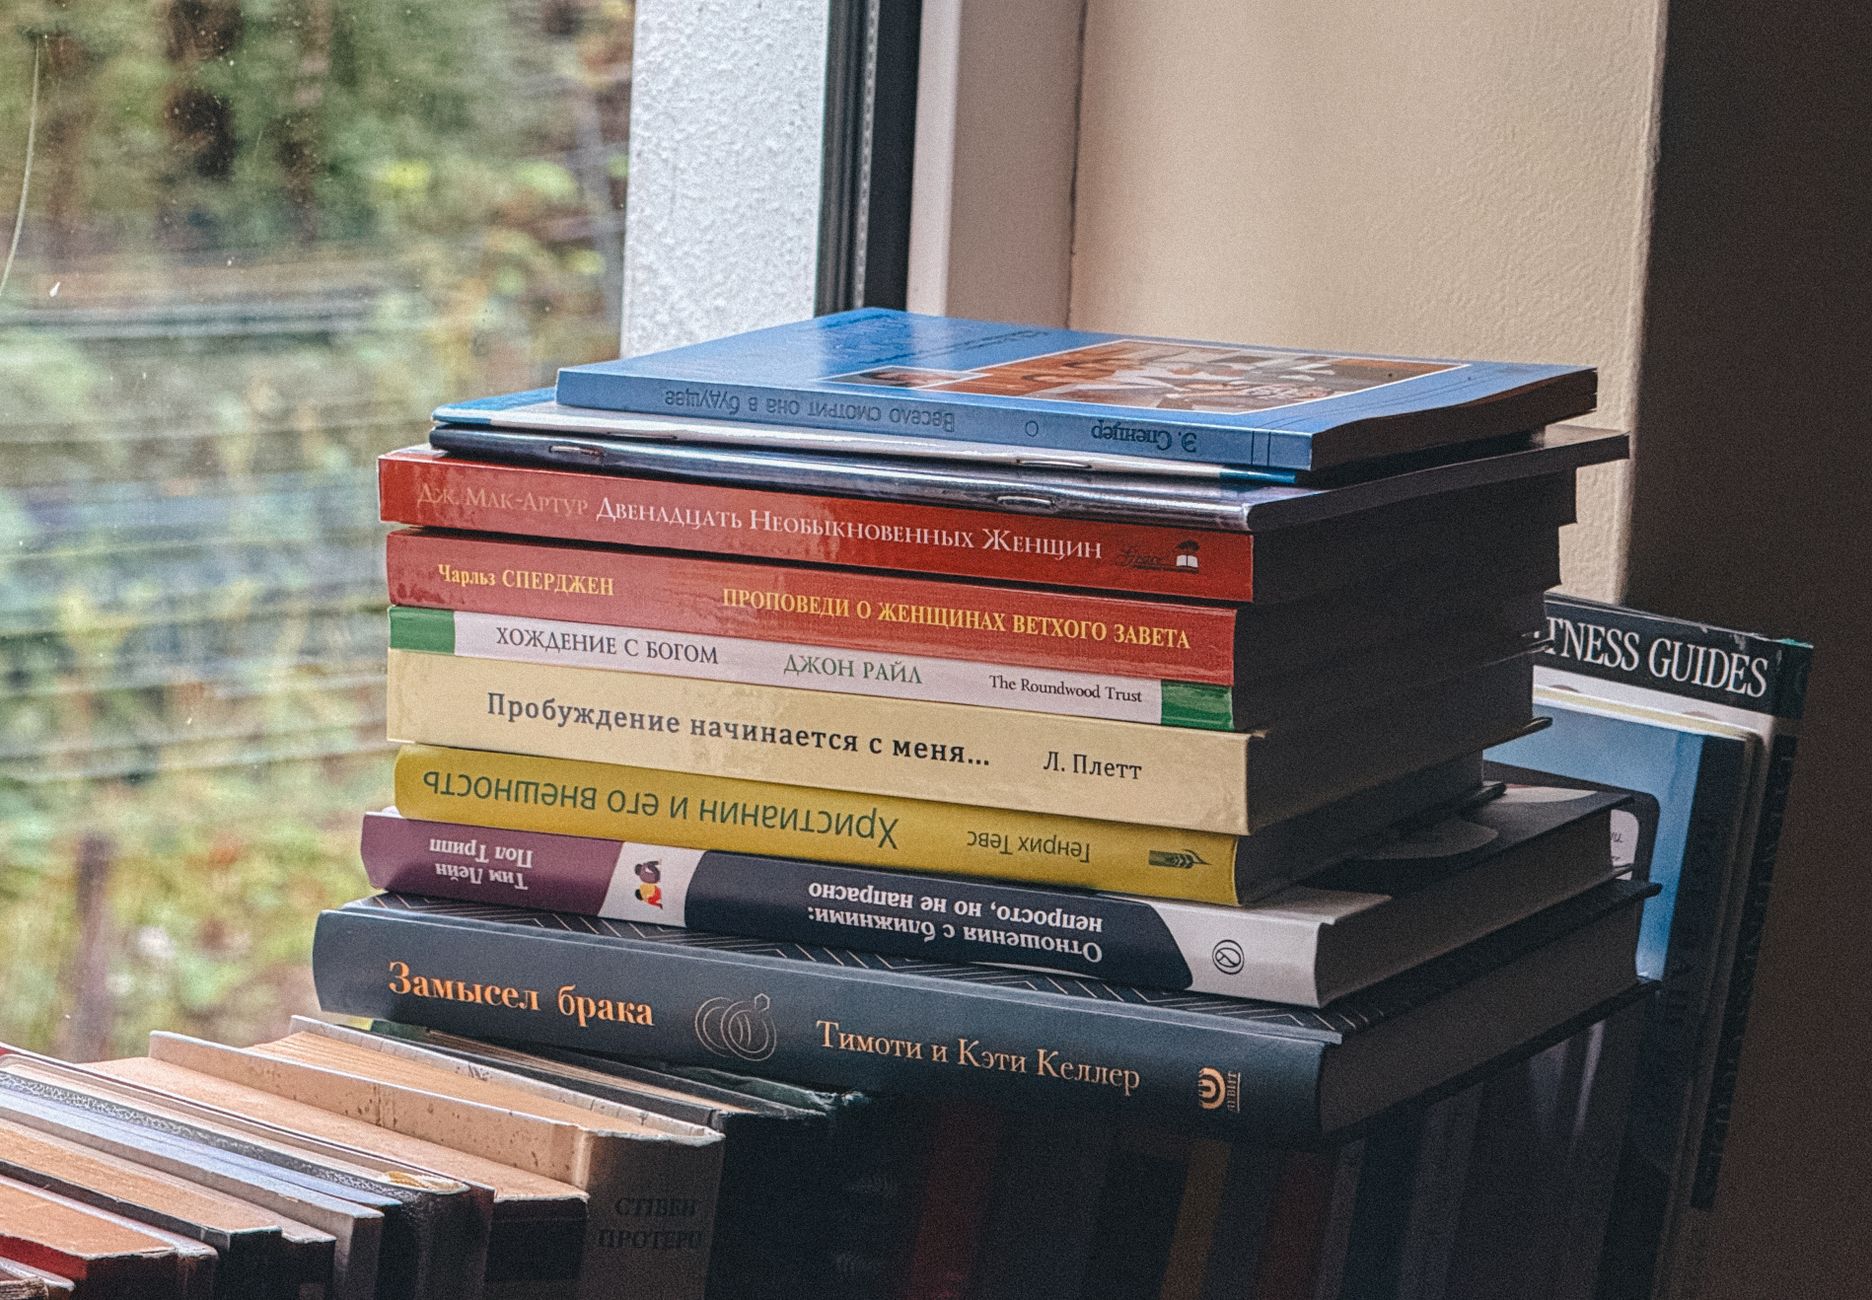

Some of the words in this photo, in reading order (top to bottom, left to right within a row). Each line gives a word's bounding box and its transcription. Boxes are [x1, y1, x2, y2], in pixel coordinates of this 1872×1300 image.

[665, 388, 740, 415] будущее
[749, 396, 758, 412] в
[767, 399, 800, 416] она
[807, 399, 880, 424] смотрит
[889, 407, 955, 433] Весело
[1091, 419, 1173, 451] Спенцер
[1176, 430, 1198, 453] Э.
[438, 564, 496, 586] Чарльз
[502, 569, 615, 596] СПЕРДЖЕН
[723, 588, 850, 618] ПРОПОВЕДИ
[856, 600, 872, 620] О
[878, 602, 1006, 633] ЖЕНЩИНАХ
[1013, 615, 1108, 642] ВЕТХОГО
[1114, 623, 1191, 650] ЗАВЕТА
[496, 626, 617, 656] ХОЖДЕНИЕ
[624, 638, 640, 657] С
[646, 640, 719, 666] БОГОМ
[1534, 615, 1640, 673] TNESS
[1649, 637, 1769, 699] GUIDES
[783, 653, 853, 677] ДЖОН
[863, 660, 922, 685] РАЙЛ
[989, 674, 1017, 690] The
[1020, 678, 1101, 699] Roundwood
[1105, 686, 1143, 703] Trust
[487, 691, 680, 734] Пробуждение
[690, 718, 858, 753] начинается
[869, 736, 882, 754] с
[892, 739, 990, 767] меня...
[1043, 750, 1066, 773] Л.
[1072, 753, 1143, 780] Плетт
[423, 770, 598, 811] внешность
[606, 788, 660, 817] его
[669, 795, 689, 820] и
[699, 798, 900, 850] Христианин
[429, 838, 490, 865] Трипп
[495, 845, 534, 869] Пол
[966, 830, 1013, 856] Тевс
[1018, 834, 1091, 863] Генрих
[435, 862, 483, 886] Лейн
[489, 870, 529, 891] Тим
[808, 881, 914, 911] напрасно
[920, 896, 947, 914] не
[953, 899, 982, 918] но
[807, 906, 936, 943] ближними:
[942, 923, 956, 939] с
[990, 901, 1104, 933] непросто,
[963, 926, 1103, 964] Отношения
[387, 960, 542, 1012] Замысел
[557, 983, 655, 1029] брака
[815, 1019, 924, 1061] Тимоти
[931, 1044, 949, 1064] и
[956, 1038, 1027, 1073] Кэти
[1035, 1047, 1141, 1098] Келлер
